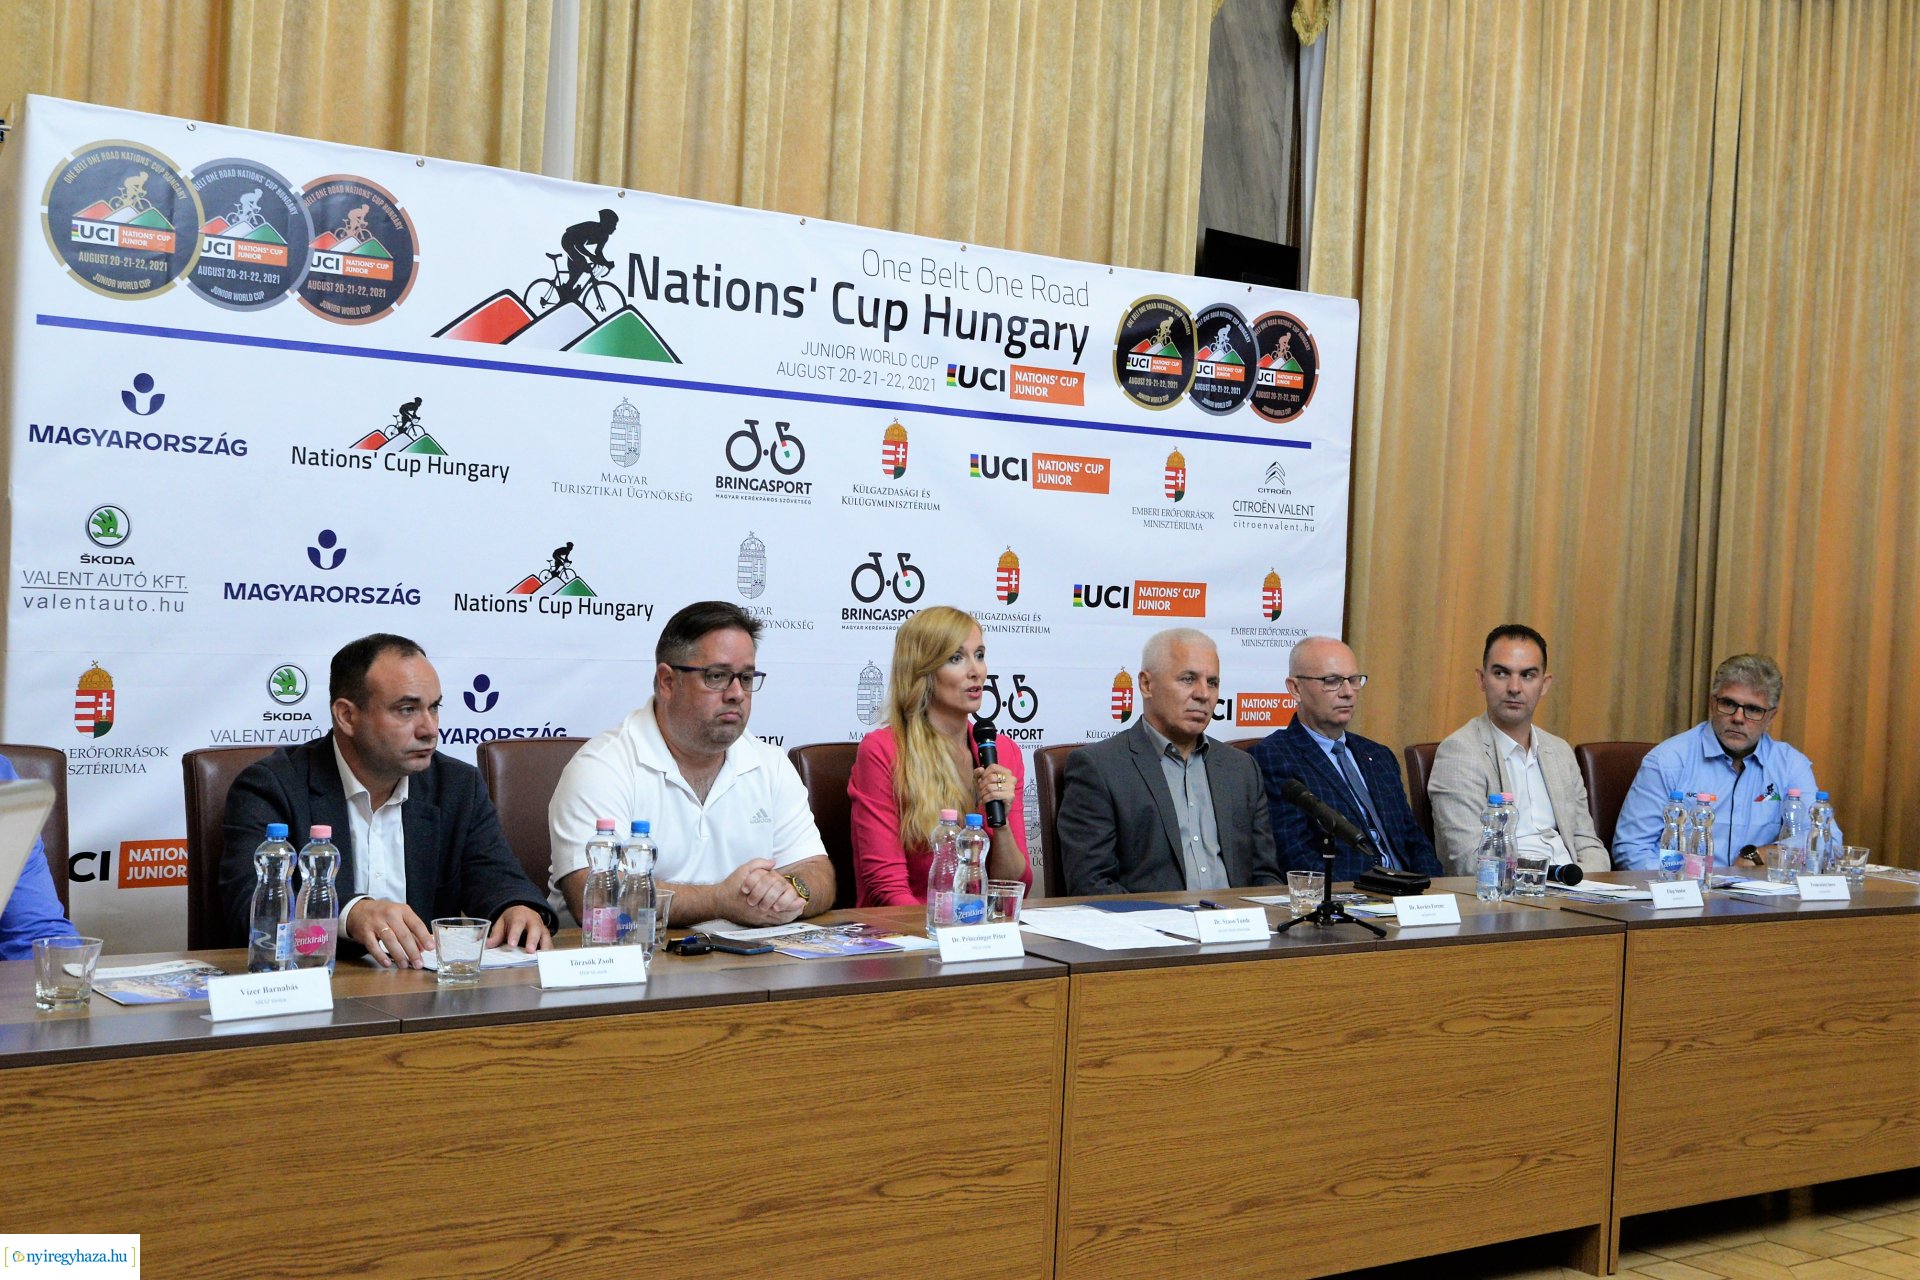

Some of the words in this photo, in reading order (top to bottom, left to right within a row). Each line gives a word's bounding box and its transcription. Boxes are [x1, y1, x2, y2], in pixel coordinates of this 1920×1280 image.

[64, 171, 76, 184] ONE
[102, 151, 119, 161] ROAD
[220, 169, 236, 178] ROAD
[265, 178, 278, 190] CUP
[276, 188, 298, 216] HUNGARY
[80, 224, 114, 242] UCI
[122, 230, 154, 240] NATIONS'
[156, 233, 171, 242] CUP
[120, 238, 148, 246] JUNIOR
[238, 252, 262, 260] JUNIOR
[270, 248, 284, 256] CUP
[78, 252, 108, 264] AUGUST
[110, 255, 148, 270] 20-21-22,
[150, 261, 168, 272] 2021
[345, 266, 368, 274] JUNIOR
[376, 262, 390, 270] CUP
[92, 273, 116, 288] JUNIOR
[117, 280, 138, 290] WORLD
[139, 278, 151, 289] CUP
[198, 266, 225, 277] AUGUST
[226, 269, 262, 282] 20-21-22,
[264, 273, 280, 284] 2021
[862, 248, 912, 282] One
[920, 256, 968, 291] Belt
[976, 266, 1023, 298] One
[1032, 275, 1089, 307] Road
[210, 286, 232, 300] JUNIOR
[233, 291, 253, 302] WORLD
[253, 290, 264, 300] CUP
[308, 280, 334, 292] AUGUST
[335, 284, 369, 297] 20-21-22,
[370, 288, 386, 298] 2021
[320, 300, 341, 314] JUNIOR
[342, 306, 360, 316] WORLD
[360, 304, 372, 314] CUP
[627, 252, 817, 319] Nations'
[832, 280, 909, 342] Cup
[924, 293, 1090, 366] Hungary
[801, 341, 856, 360] JUNIOR
[860, 347, 907, 366] WORLD
[912, 354, 939, 370] CUP
[1132, 358, 1149, 368] UCI
[776, 361, 835, 380] AUGUST
[840, 368, 905, 390] 20-21-22,
[908, 376, 936, 392] 2021
[956, 366, 1006, 392] UCI
[1014, 370, 1058, 384] NATIONS'
[1060, 374, 1079, 388] CUP
[1014, 382, 1049, 398] JUNIOR
[28, 424, 248, 457] MAGYARORSZÁG
[292, 446, 378, 470] Nations'
[384, 453, 421, 477] Cup
[428, 456, 510, 484] Hungary
[981, 455, 1028, 482] UCI
[1037, 459, 1082, 473] NATIONS'
[1084, 464, 1104, 474] CUP
[600, 472, 648, 486] MAGYAR
[716, 476, 812, 494] BRINGASPORT
[1036, 472, 1072, 486] JUNIOR
[552, 481, 622, 498] TURISZTIKAI
[627, 486, 693, 502] ÜGYNÖKSÉG
[741, 494, 778, 502] KERÉKPÁROS
[852, 484, 918, 498] KÜLGAZDASÁGI
[921, 488, 930, 498] ÉS
[841, 496, 940, 511] KÜLÜGYMINISZTÉRIUM
[1232, 500, 1276, 515] CITROËN
[1278, 503, 1315, 517] VALENT
[1132, 506, 1160, 518] EMBERI
[1162, 507, 1214, 520] ERŐFORRÁSOK
[1144, 519, 1203, 532] MINISZTÉRIUMA
[1234, 520, 1315, 532] citroenvalent.hu
[80, 553, 135, 566] ŠKODA
[23, 570, 94, 586] VALENT
[98, 571, 147, 588] AUTÓ
[152, 575, 187, 589] KFT.
[224, 582, 421, 606] MAGYARORSZÁG
[1084, 585, 1130, 609] UCI
[1138, 586, 1181, 598] NATIONS'
[1182, 588, 1200, 598] CUP
[24, 594, 184, 612] valentauto.hu
[454, 593, 533, 614] Nations'
[538, 596, 572, 618] Cup
[578, 598, 654, 622] Hungary
[1137, 600, 1170, 610] JUNIOR
[842, 608, 920, 621] BRINGASPO
[1033, 612, 1042, 622] ÉS
[981, 624, 1050, 634] GYMINISZTÉRIUM
[1231, 628, 1257, 636] EMBERI
[1258, 626, 1308, 637] ERŐFORRÁSOK
[1212, 698, 1232, 720] CI
[1242, 698, 1280, 708] NATIONS'
[263, 711, 312, 721] ŠKODA
[1240, 711, 1270, 721] JUNIOR
[210, 729, 276, 742] VALENT
[280, 726, 322, 742] AUTÓ
[438, 722, 567, 744] YARORSZÁG
[69, 745, 168, 759] ERŐFORRÁSOK
[68, 762, 147, 775] SZTÉRIUMA
[129, 848, 188, 863] NATION
[68, 851, 111, 882] CI
[126, 864, 188, 881] JUNIOR
